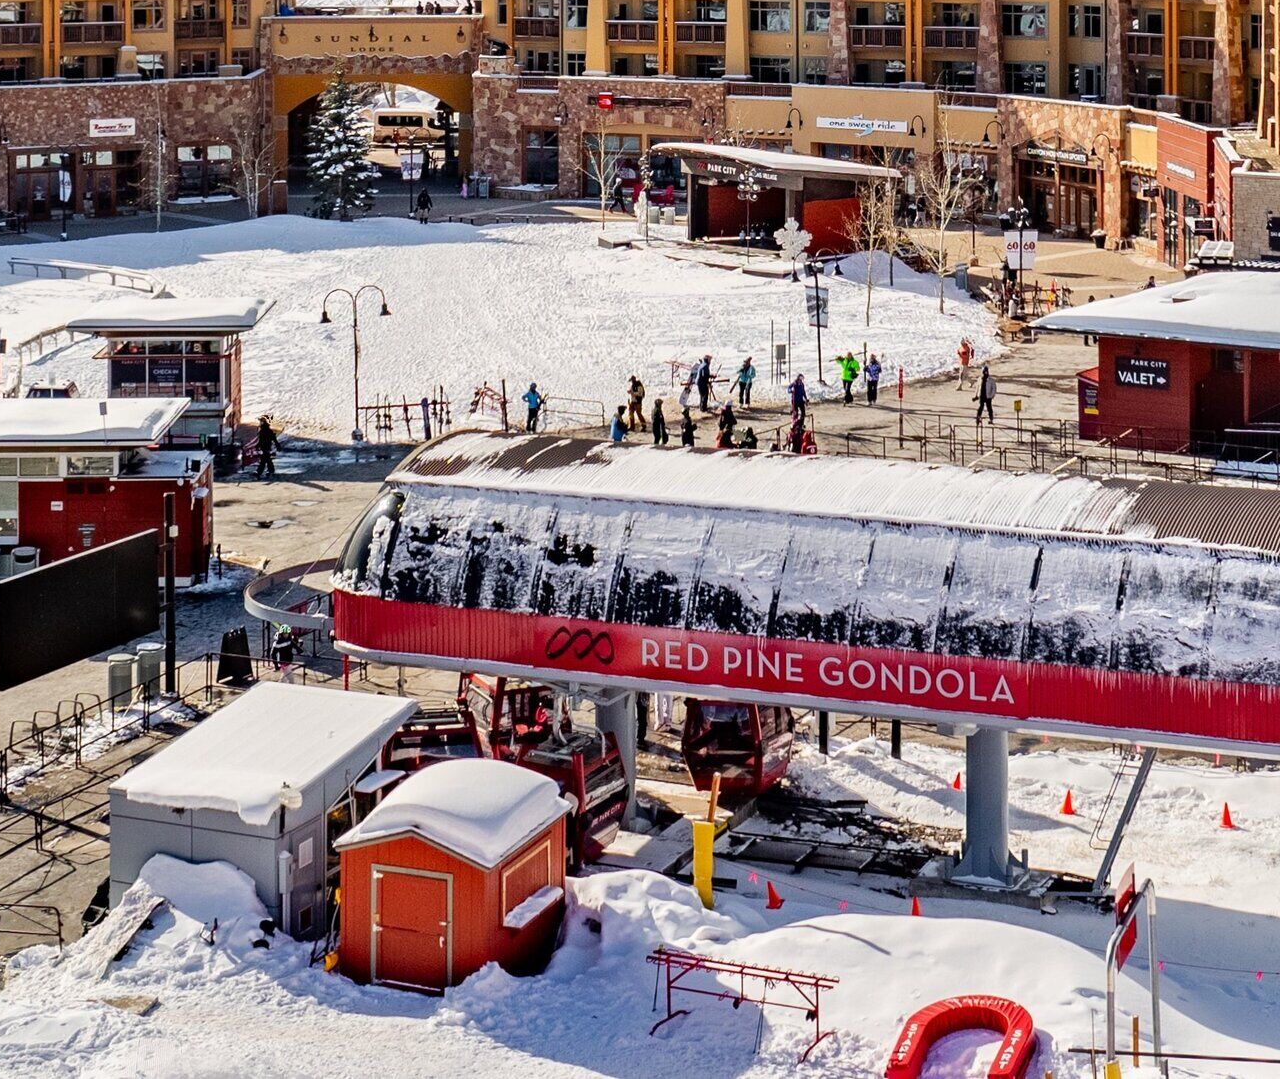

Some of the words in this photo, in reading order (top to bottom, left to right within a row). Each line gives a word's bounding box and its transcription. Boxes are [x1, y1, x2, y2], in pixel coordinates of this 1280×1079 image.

[848, 120, 874, 129] sweet
[877, 121, 896, 130] ride
[707, 163, 722, 173] PARK
[722, 166, 737, 175] CITY
[1007, 241, 1018, 250] 60
[1023, 241, 1036, 250] 60
[1130, 359, 1149, 367] PARK
[1118, 370, 1156, 385] VALET
[641, 638, 710, 673] RED
[723, 646, 804, 683] PINE
[818, 656, 1016, 705] GONDOLA
[897, 1023, 919, 1061] START
[998, 1029, 1023, 1070] START
